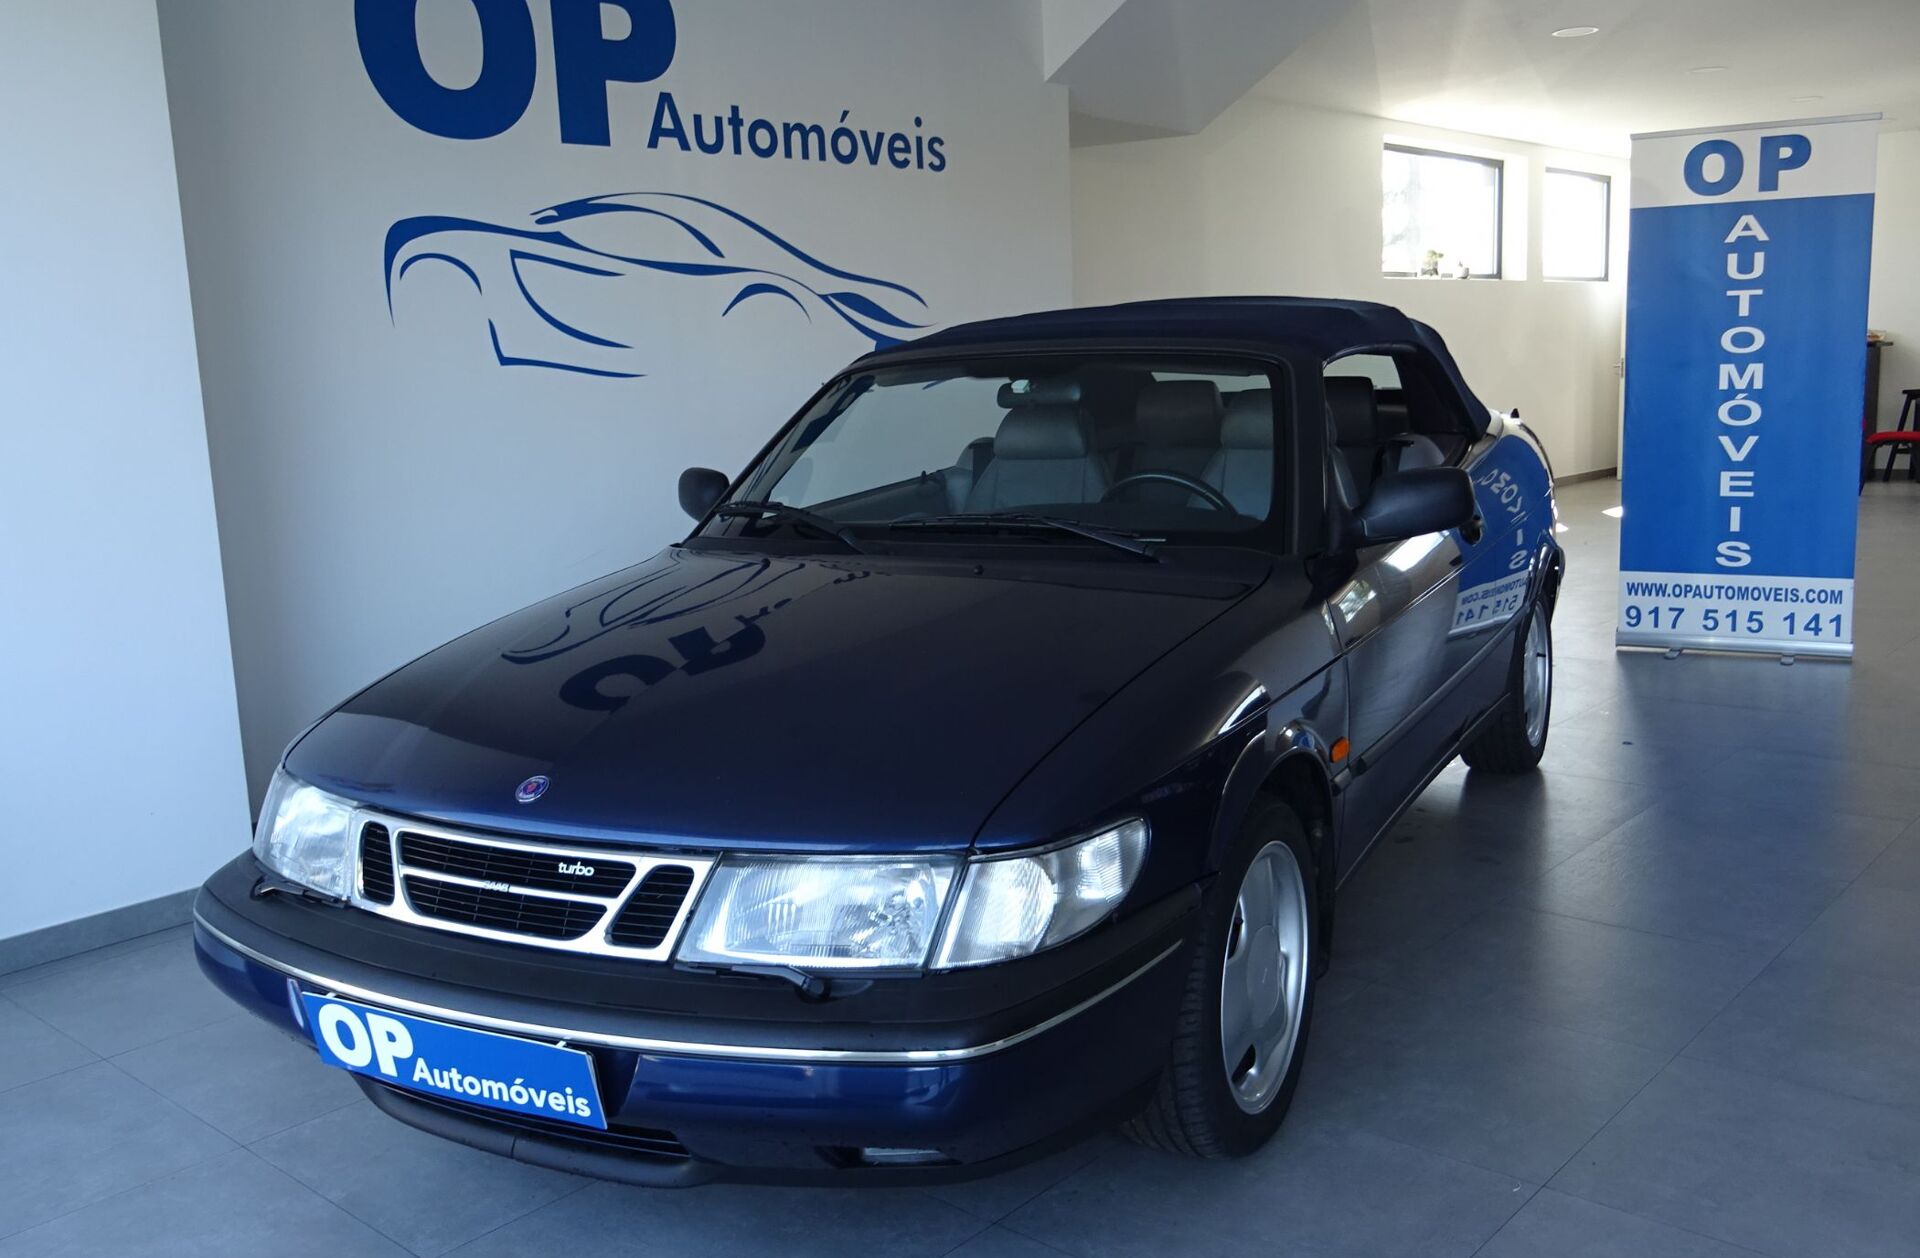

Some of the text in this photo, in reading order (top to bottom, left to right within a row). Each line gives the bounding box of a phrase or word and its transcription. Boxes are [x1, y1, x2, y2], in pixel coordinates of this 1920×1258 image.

[354, 0, 677, 147] OP
[647, 91, 947, 173] Automóveis
[1683, 133, 1813, 197] OP
[1714, 214, 1770, 568] AUTOMÓVEIS
[1625, 604, 1843, 638] 917 515 141
[1626, 581, 1844, 605] WWW.OPAUTOMOVEIS.COM
[558, 860, 595, 877] turbo
[318, 1003, 415, 1078] OP
[412, 1057, 592, 1118] Automóveis
